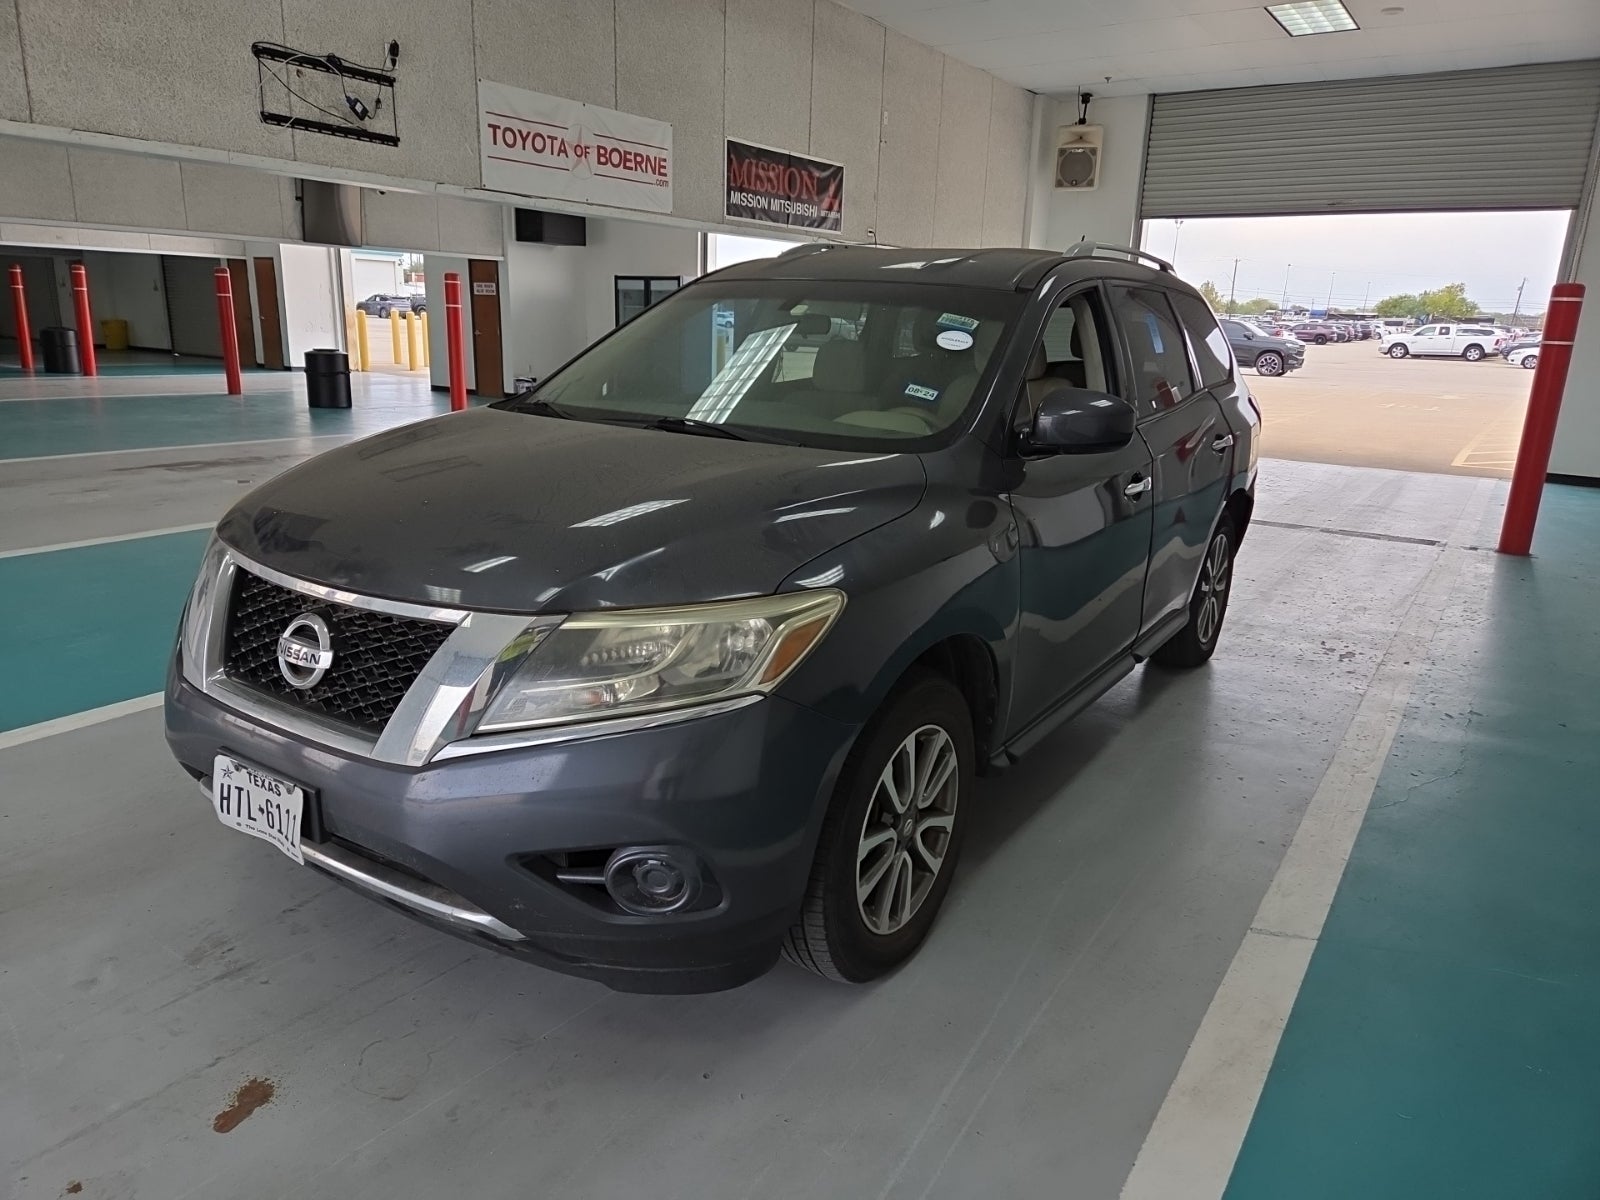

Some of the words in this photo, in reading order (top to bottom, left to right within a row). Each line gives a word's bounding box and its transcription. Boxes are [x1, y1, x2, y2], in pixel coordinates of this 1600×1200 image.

[487, 123, 569, 158] TOYOTA
[574, 144, 590, 159] OF
[596, 145, 667, 177] BOERNE
[729, 153, 818, 202] MISSION
[730, 190, 768, 210] MISSION
[770, 198, 818, 218] MITSUBISHI
[280, 642, 321, 665] NISSAN
[246, 770, 281, 797] TEXAS
